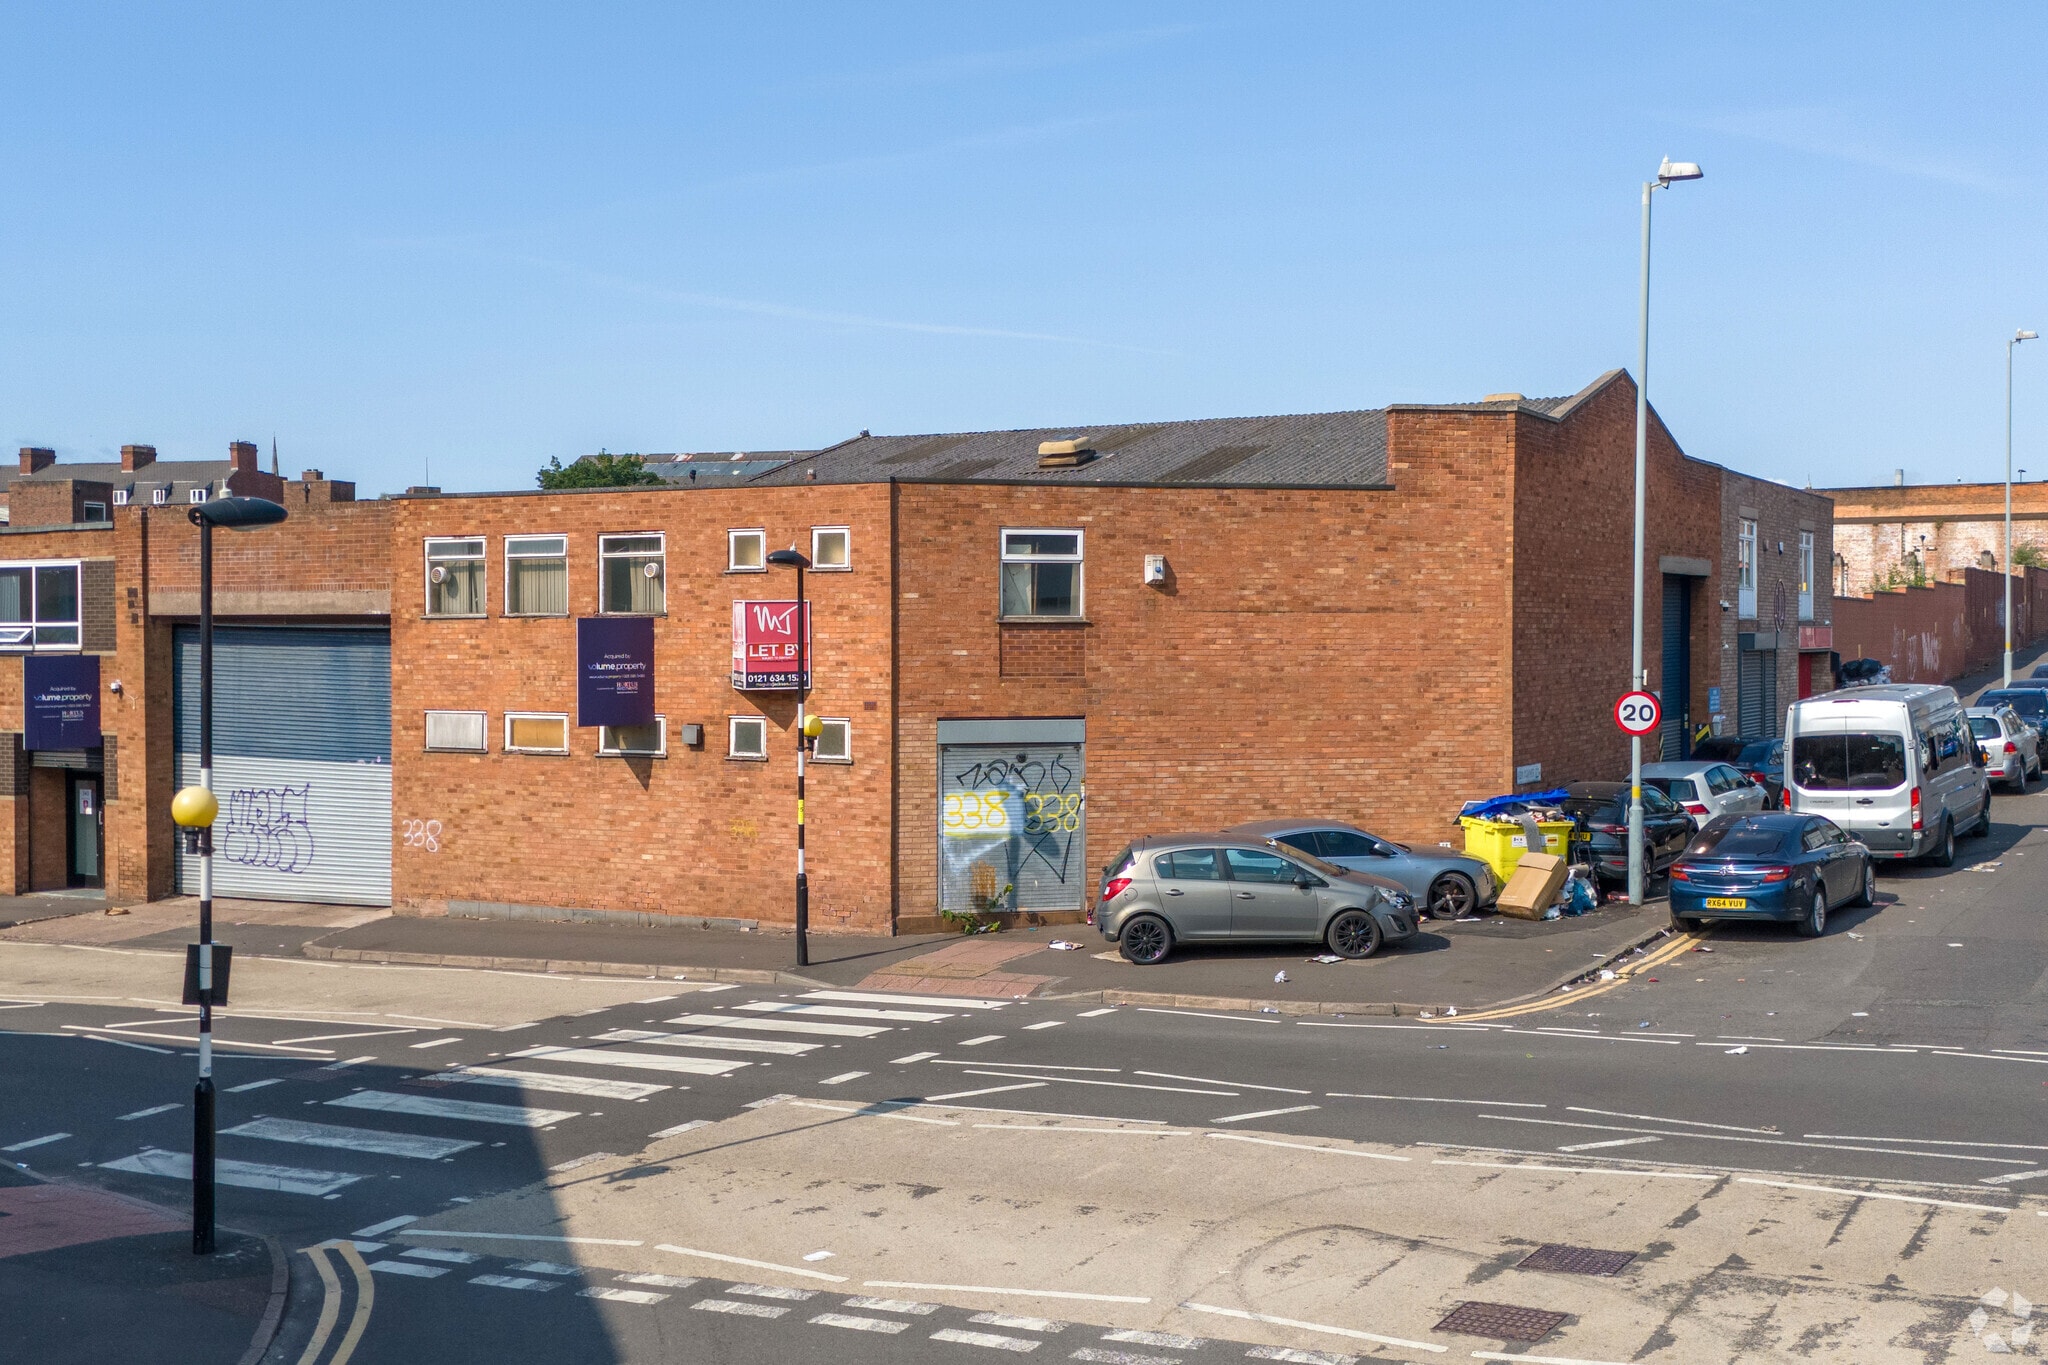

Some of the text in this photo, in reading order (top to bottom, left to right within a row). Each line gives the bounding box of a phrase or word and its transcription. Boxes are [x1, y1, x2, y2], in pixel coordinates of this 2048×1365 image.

[749, 644, 779, 657] LET
[588, 662, 646, 671] volume.property
[748, 674, 767, 682] 0121
[1623, 704, 1654, 722] 20
[943, 790, 1010, 829] 338
[1024, 792, 1080, 832] 338
[402, 819, 442, 852] 338
[1706, 899, 1744, 907] RX64 VUV
